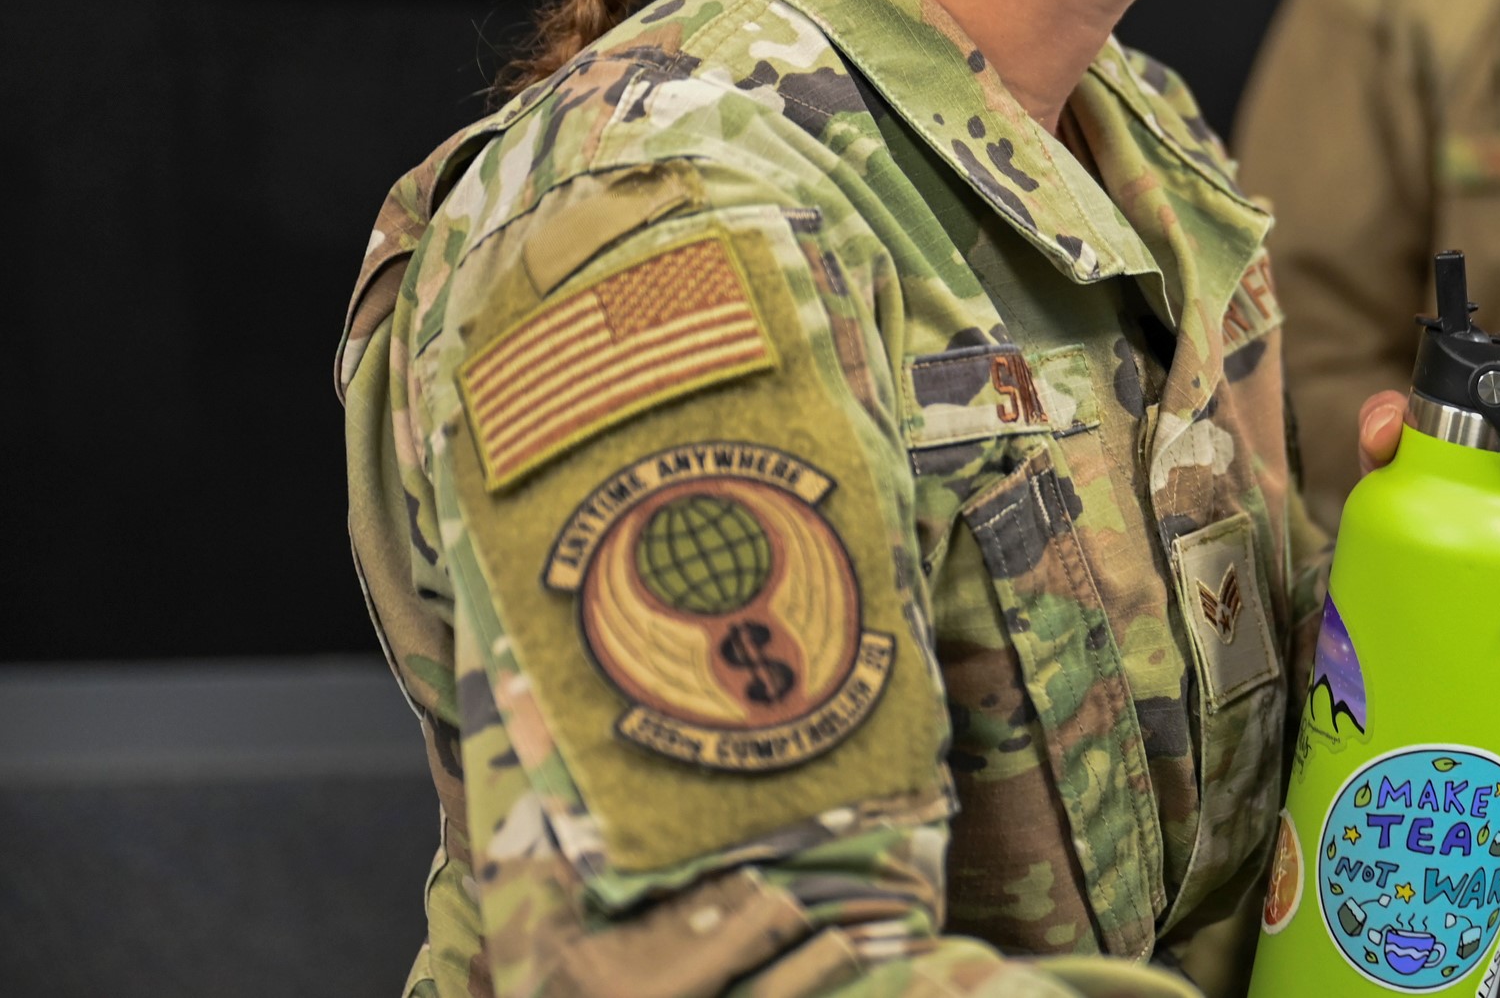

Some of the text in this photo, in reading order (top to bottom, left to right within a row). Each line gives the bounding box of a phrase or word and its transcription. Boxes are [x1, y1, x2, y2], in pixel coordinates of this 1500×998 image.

[555, 450, 803, 569] ANYTIME ANYWHERE
[1376, 776, 1493, 819] MAKE
[1366, 813, 1473, 857] TEA
[1334, 856, 1400, 889] NOT
